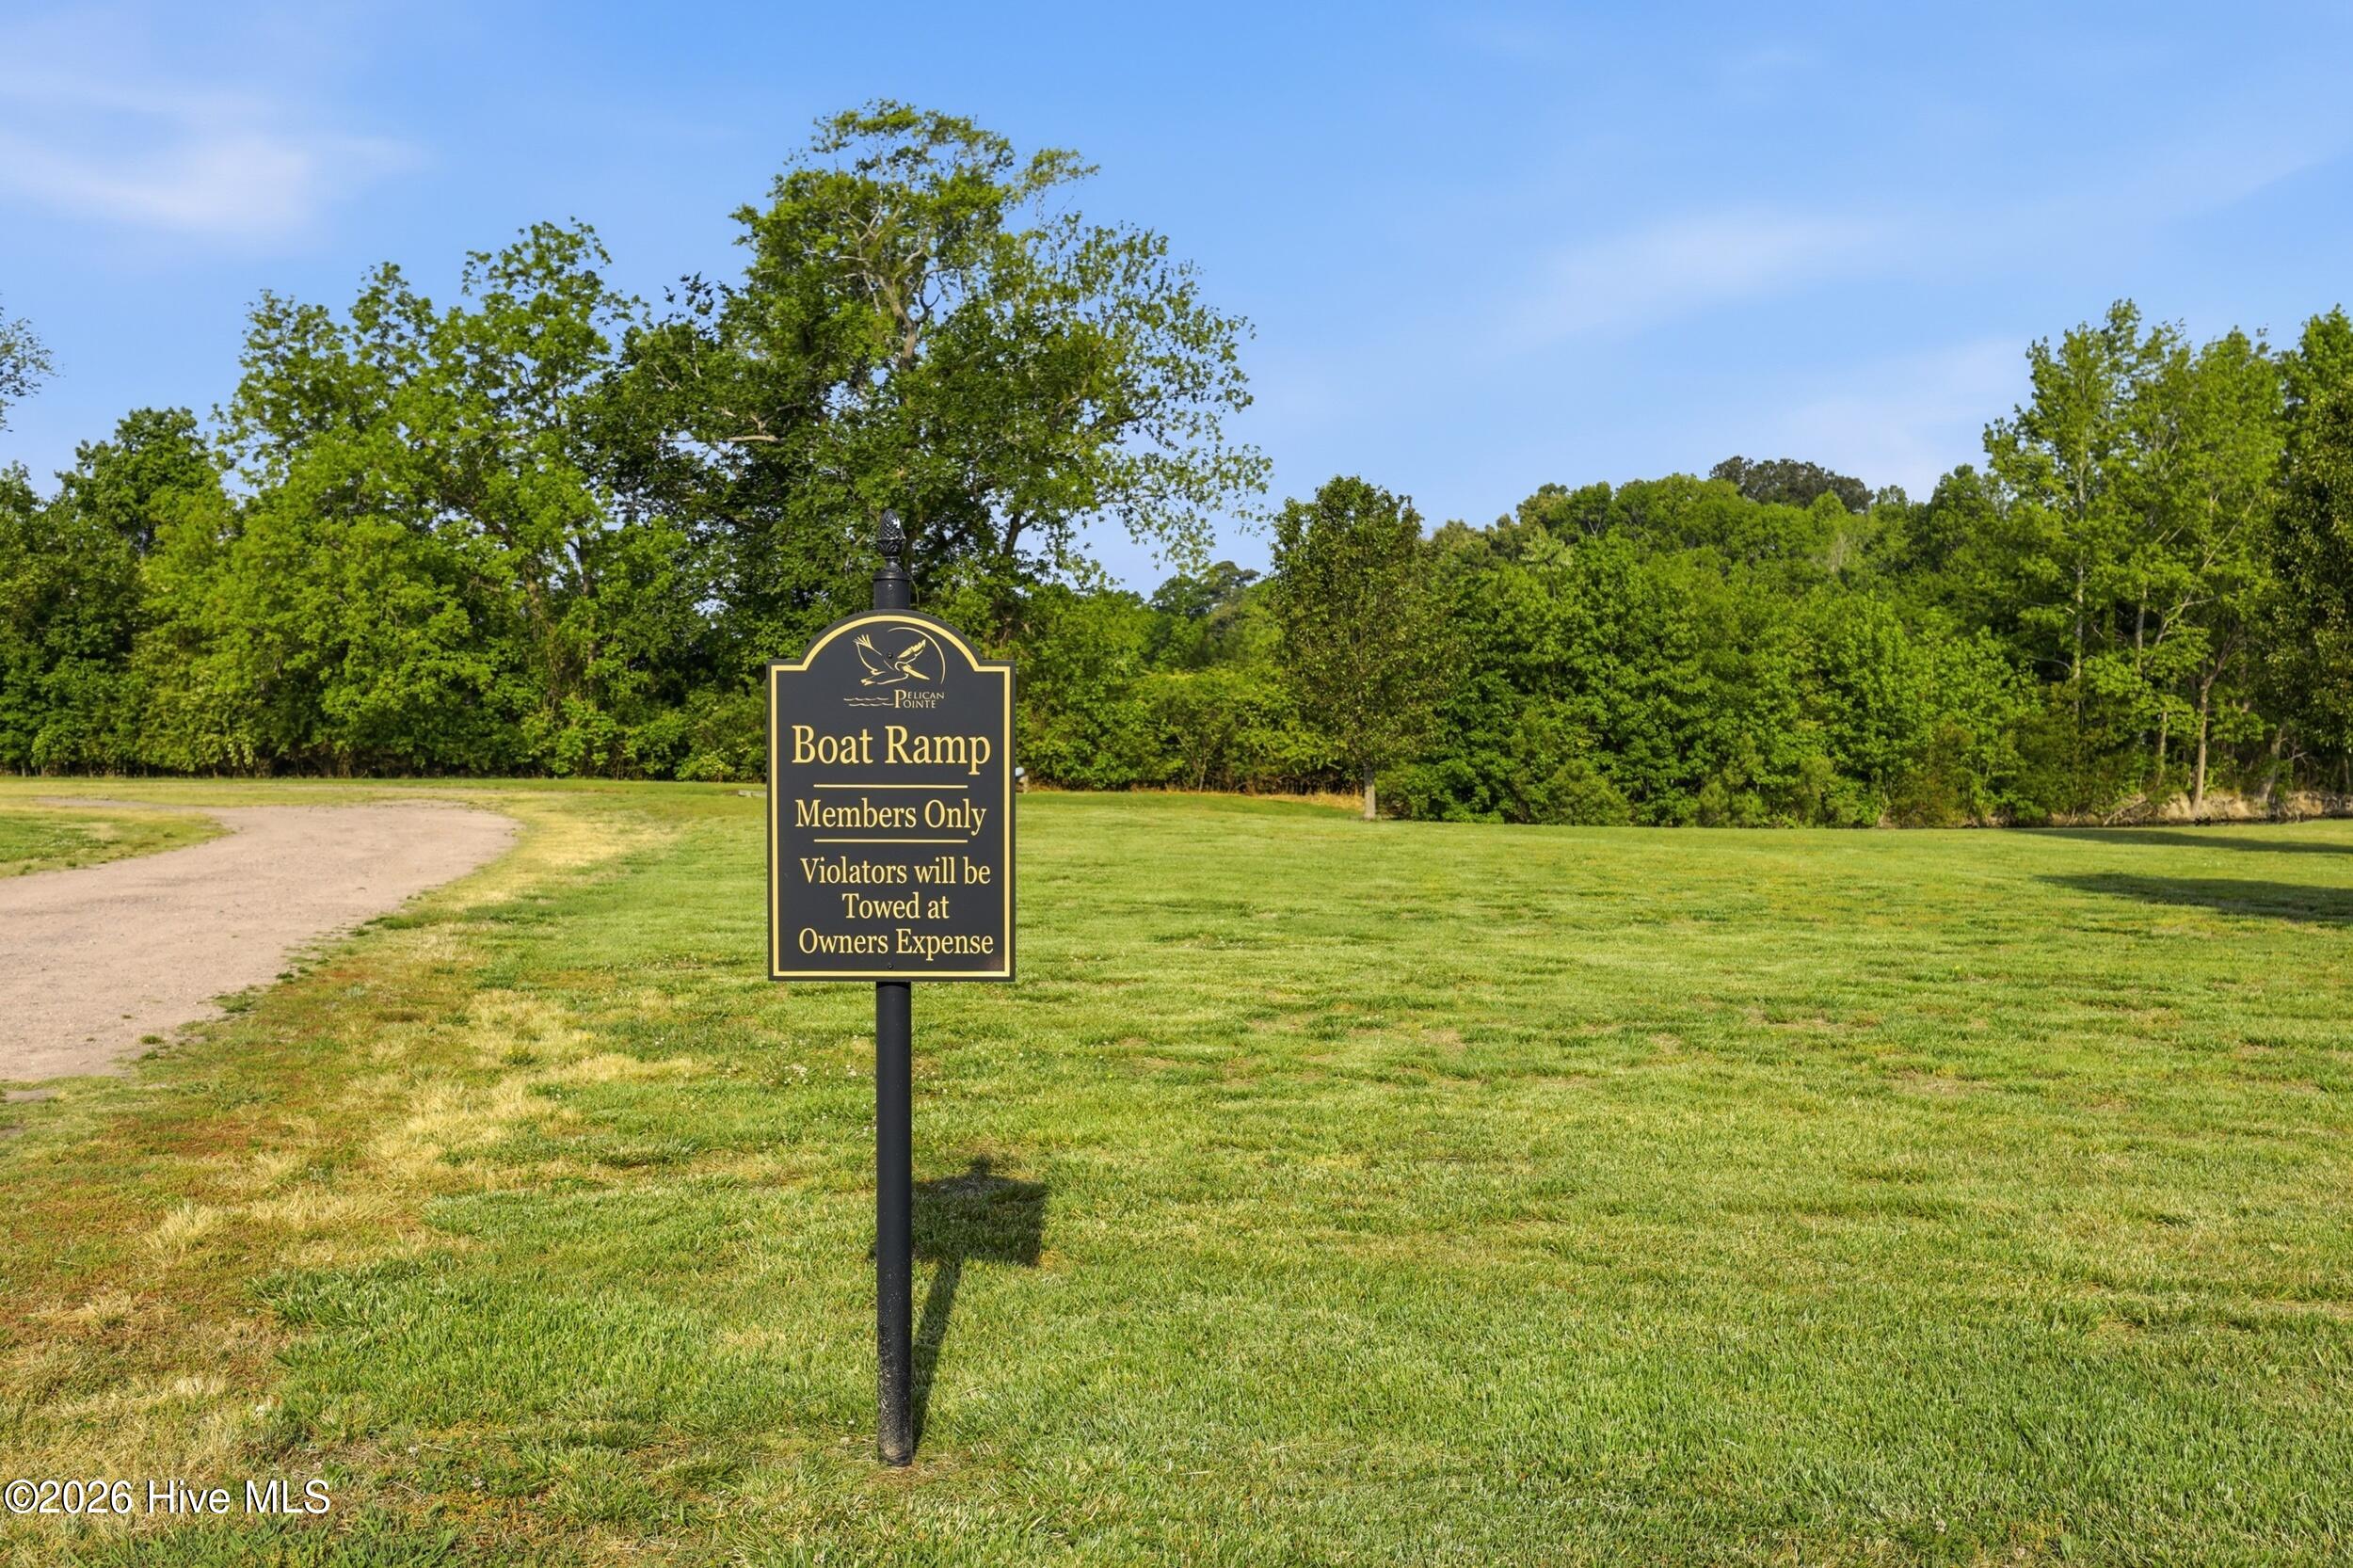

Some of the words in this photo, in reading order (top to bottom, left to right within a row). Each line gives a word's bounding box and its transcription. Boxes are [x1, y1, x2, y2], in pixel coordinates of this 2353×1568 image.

[893, 690, 944, 708] PELICAN
[792, 725, 873, 764] Boat
[885, 726, 990, 775] Ramp
[795, 797, 917, 827] Members
[925, 798, 986, 836] Only
[800, 856, 907, 884] Violators
[914, 856, 956, 884] will
[963, 856, 990, 884] be
[842, 891, 920, 919] Towed
[928, 896, 950, 919] at
[799, 928, 888, 953] Owners
[896, 929, 993, 961] Expense
